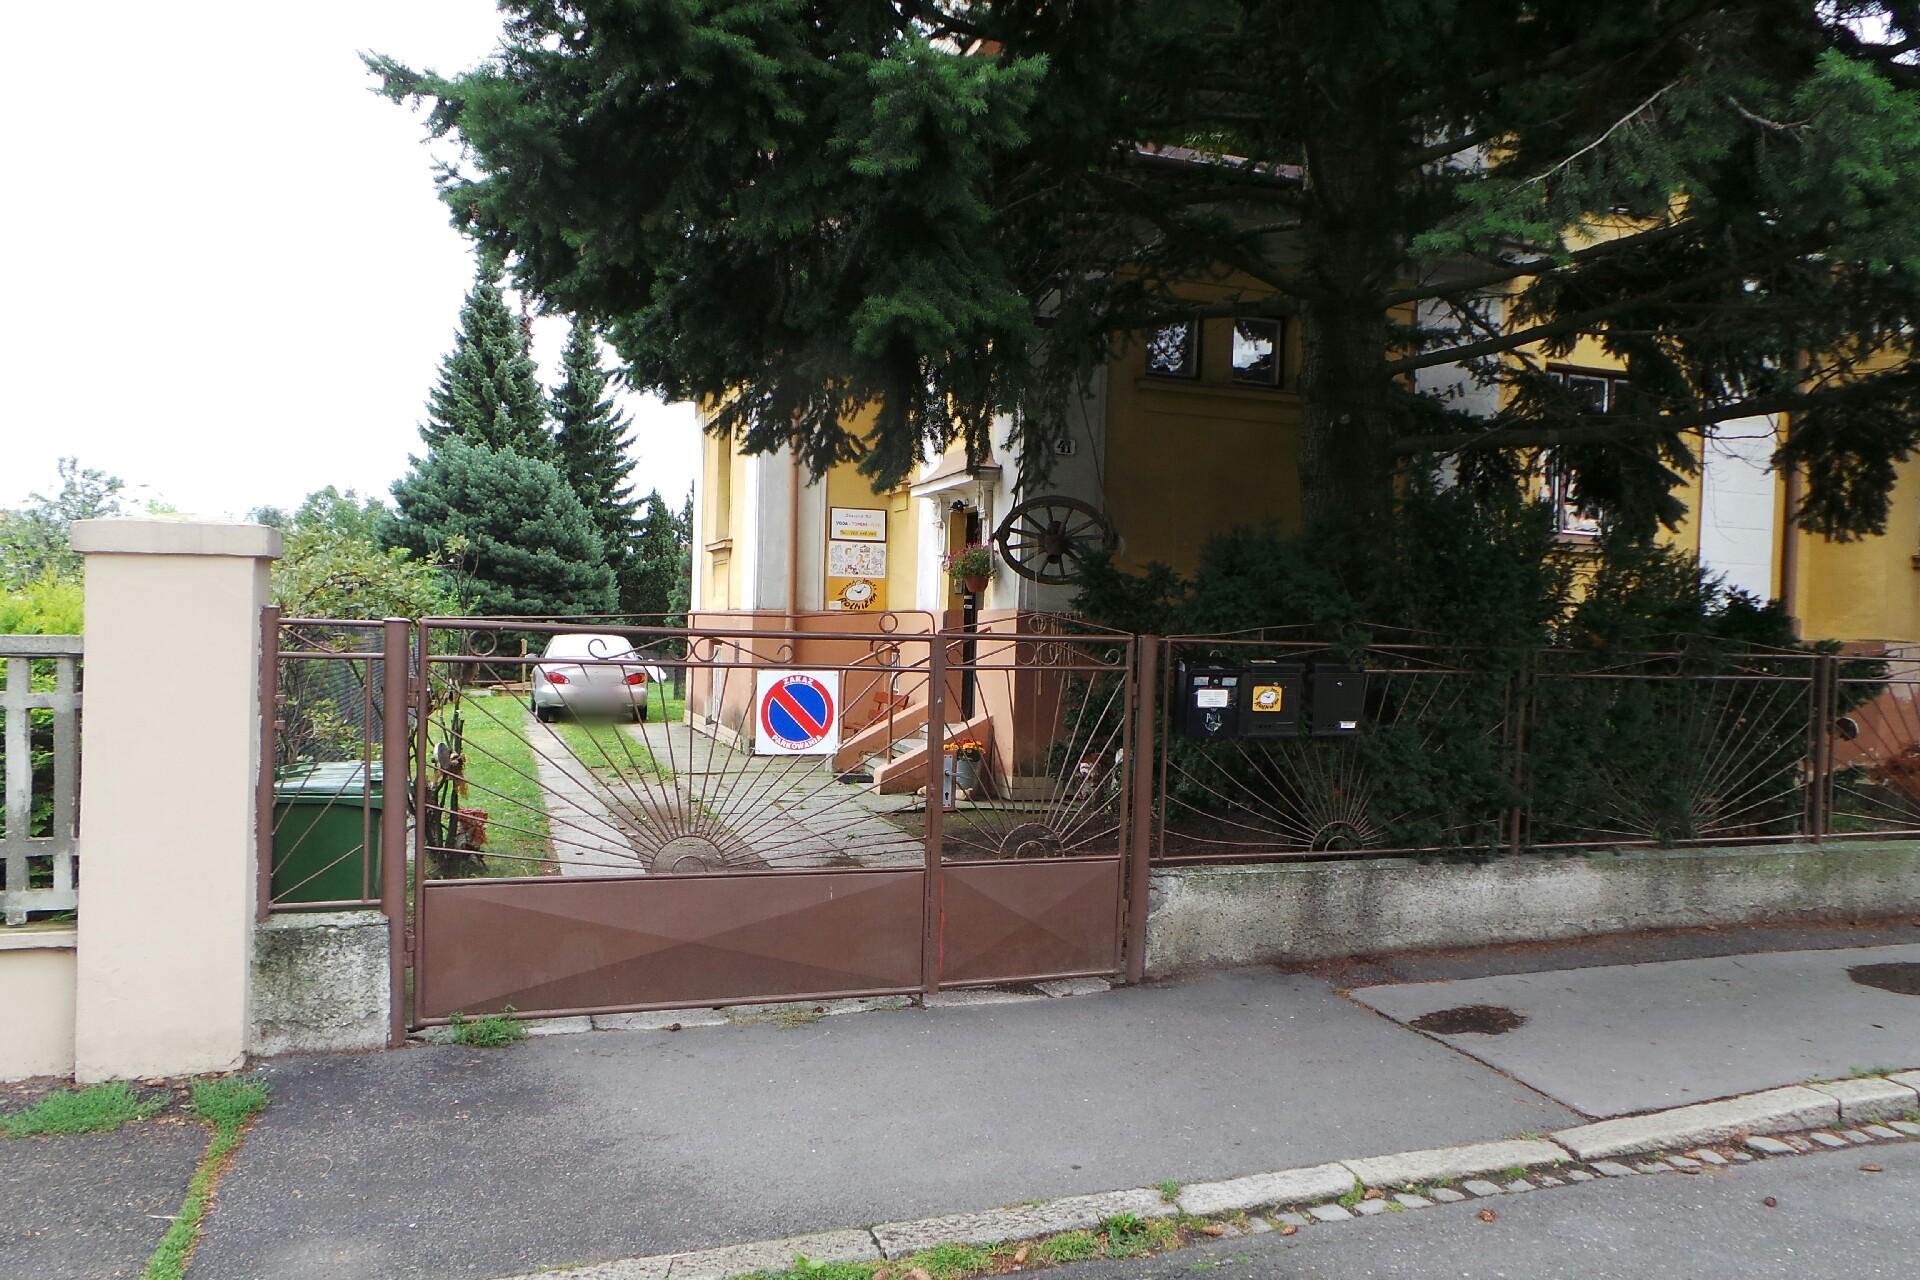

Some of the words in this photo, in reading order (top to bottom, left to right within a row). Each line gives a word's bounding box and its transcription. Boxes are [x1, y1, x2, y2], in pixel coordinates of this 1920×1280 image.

[1056, 440, 1073, 454] 41
[783, 675, 814, 685] ZAKAZ
[771, 734, 823, 750] PARKOWANIA
